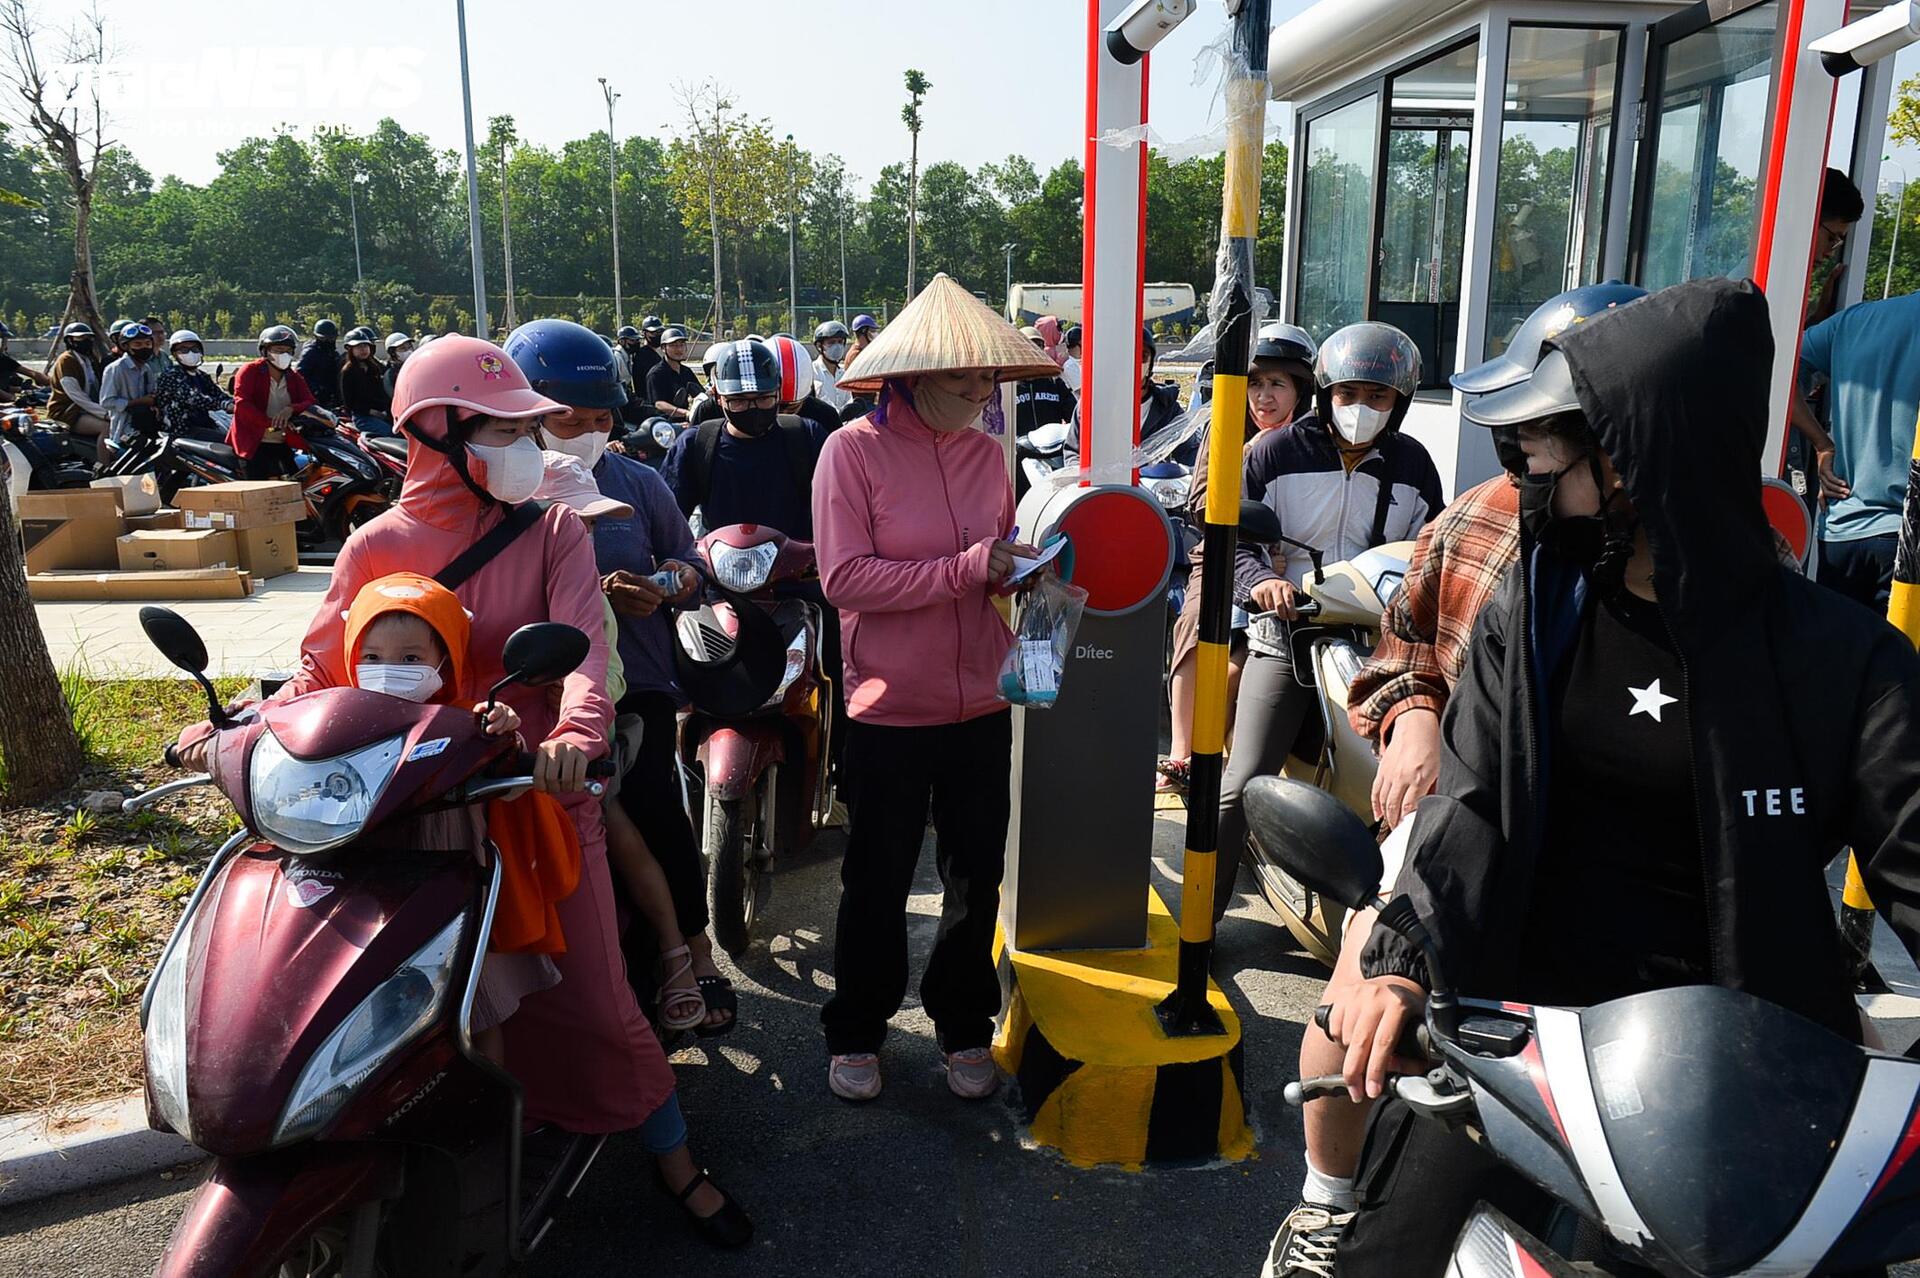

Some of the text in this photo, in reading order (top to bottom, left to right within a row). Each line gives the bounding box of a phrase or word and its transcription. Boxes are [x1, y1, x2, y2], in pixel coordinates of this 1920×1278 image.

[576, 364, 607, 372] HONDA
[1742, 788, 1805, 816] TEE
[384, 1072, 448, 1126] HONDA
